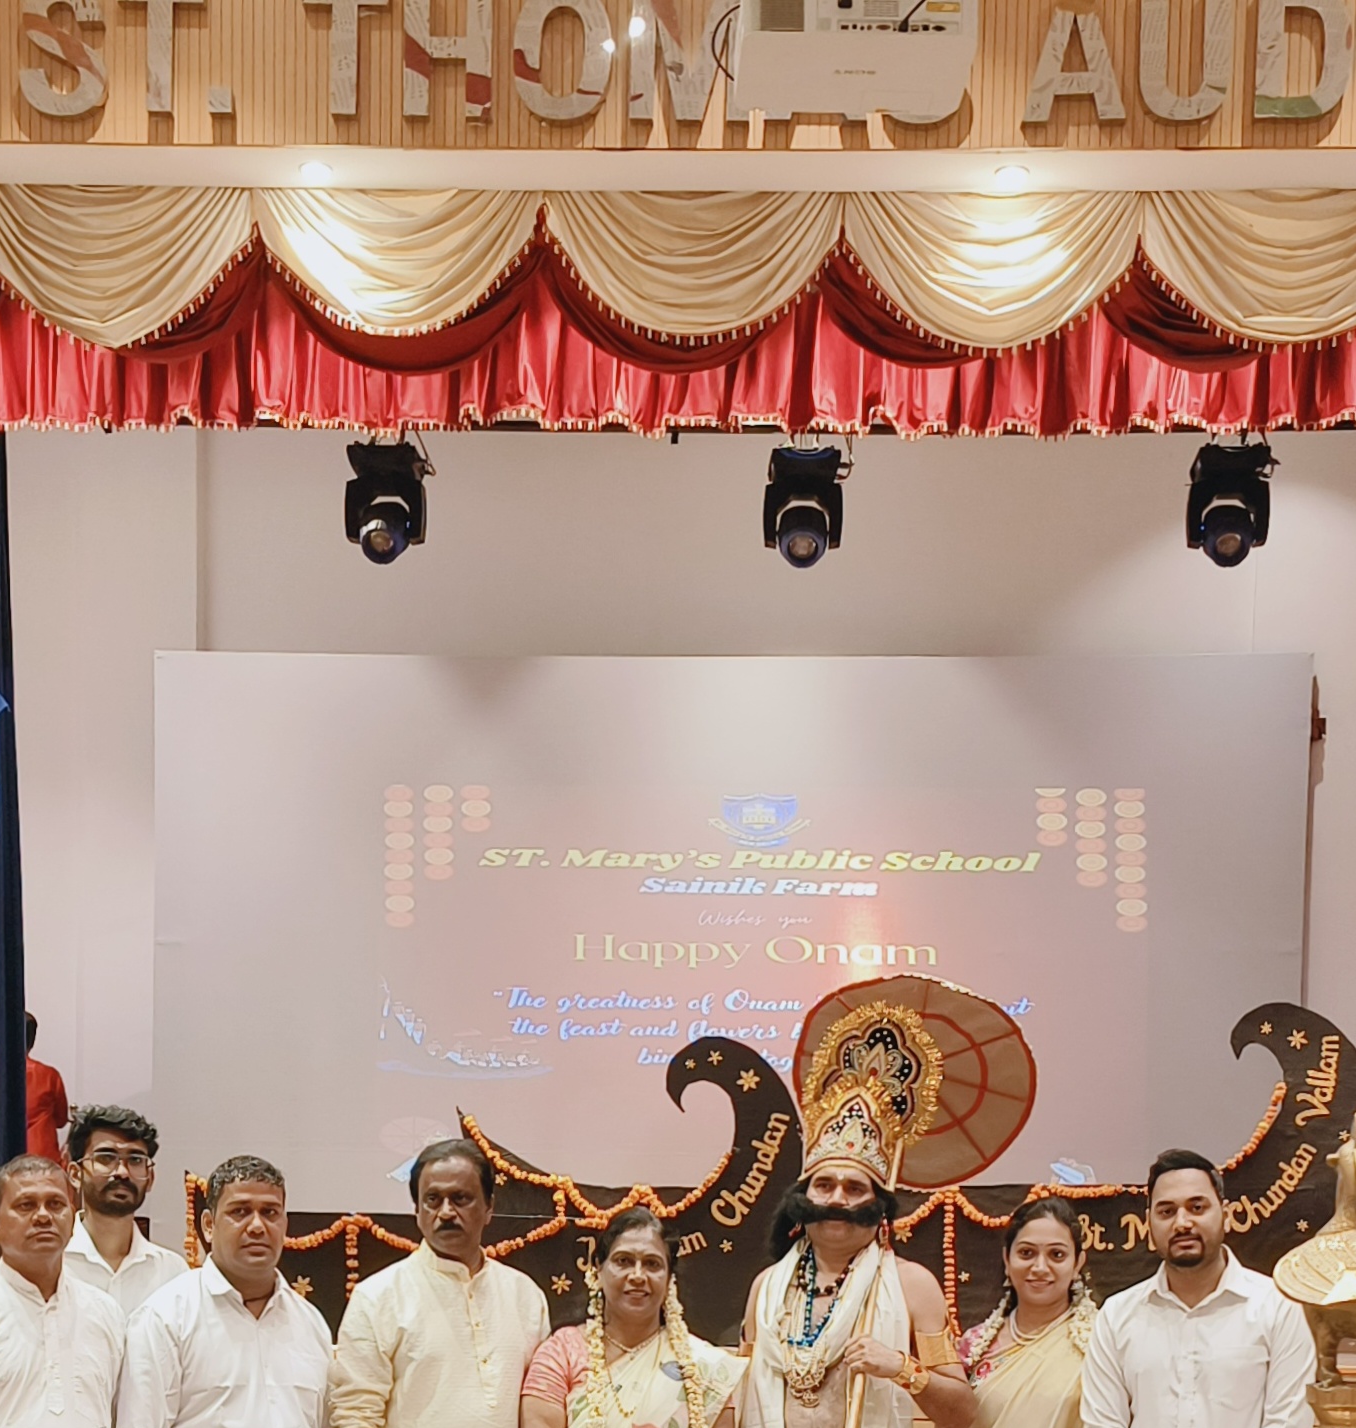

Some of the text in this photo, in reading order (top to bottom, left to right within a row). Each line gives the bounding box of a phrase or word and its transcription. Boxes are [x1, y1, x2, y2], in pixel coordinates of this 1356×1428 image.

[18, 0, 232, 116] ST.
[304, 0, 958, 122] THOM
[478, 847, 1042, 873] ST. Mary's Public School
[639, 876, 880, 897] Sainik Farm
[697, 909, 813, 929] Wishes you
[573, 932, 938, 969] Happy Onam
[557, 990, 679, 1014] greatness
[687, 992, 715, 1015] of
[724, 988, 803, 1012] Onam
[508, 1016, 550, 1037] the
[559, 1018, 627, 1041] feast
[630, 1019, 679, 1038] and
[687, 1019, 781, 1044] flowers
[1227, 1142, 1318, 1234] Chundan
[1295, 1034, 1340, 1127] Vallam
[710, 1111, 791, 1227] Chundan
